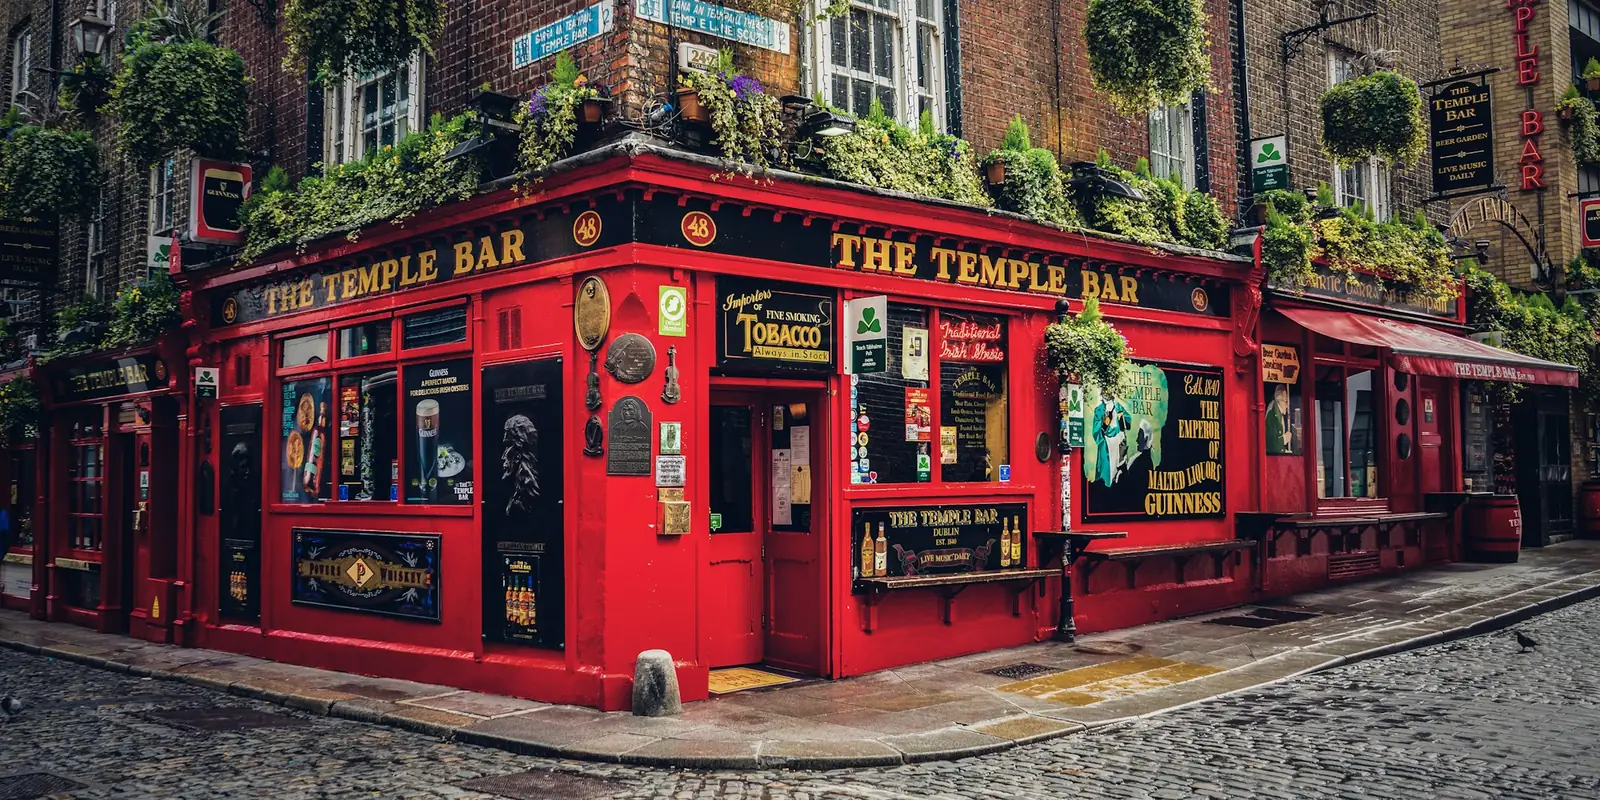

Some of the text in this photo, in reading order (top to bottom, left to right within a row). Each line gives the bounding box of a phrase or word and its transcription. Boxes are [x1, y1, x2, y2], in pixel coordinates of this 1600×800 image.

[670, 11, 706, 30] TEMPE
[1449, 86, 1470, 96] THE
[1433, 92, 1489, 111] TEMPLE
[1446, 108, 1476, 121] BAR
[1436, 132, 1488, 147] BEER GARDEN
[1519, 108, 1548, 191] BAR
[1438, 160, 1487, 174] LIVE MUSIC
[1449, 171, 1476, 181] DAILY
[207, 189, 239, 199] GUINNESS
[578, 217, 597, 242] 48
[688, 216, 710, 239] 48
[265, 228, 526, 315] THE TEMPLE BAR
[833, 231, 1140, 304] THE TEMPLE BAR
[723, 289, 772, 313] Importers
[753, 303, 763, 311] OF
[766, 309, 821, 323] FINE SMOKING
[736, 312, 822, 353] TOBACCO
[940, 322, 1001, 339] Traditional
[754, 346, 829, 361] Always in Stock
[125, 363, 150, 386] BAR
[429, 368, 449, 378] GUINNESS
[953, 371, 981, 390] TEMPLE
[1131, 371, 1153, 386] THE
[1454, 363, 1471, 375] THE
[1471, 363, 1502, 378] TEMPLE
[1502, 367, 1517, 380] BAR
[1132, 401, 1154, 416] BAR
[1200, 400, 1219, 420] THE
[1178, 419, 1221, 440] EMPEROR
[1208, 441, 1220, 459] OF
[1148, 460, 1222, 491] MALTED LIQUORS
[1144, 491, 1221, 516] GUINNESS
[889, 507, 1000, 528] THE TEMPLE BAR
[933, 527, 960, 537] DUBLIN
[920, 551, 972, 565] LIVE MUSIC DAILY
[309, 562, 341, 577] POWERS
[379, 568, 422, 584] WHISKEY
